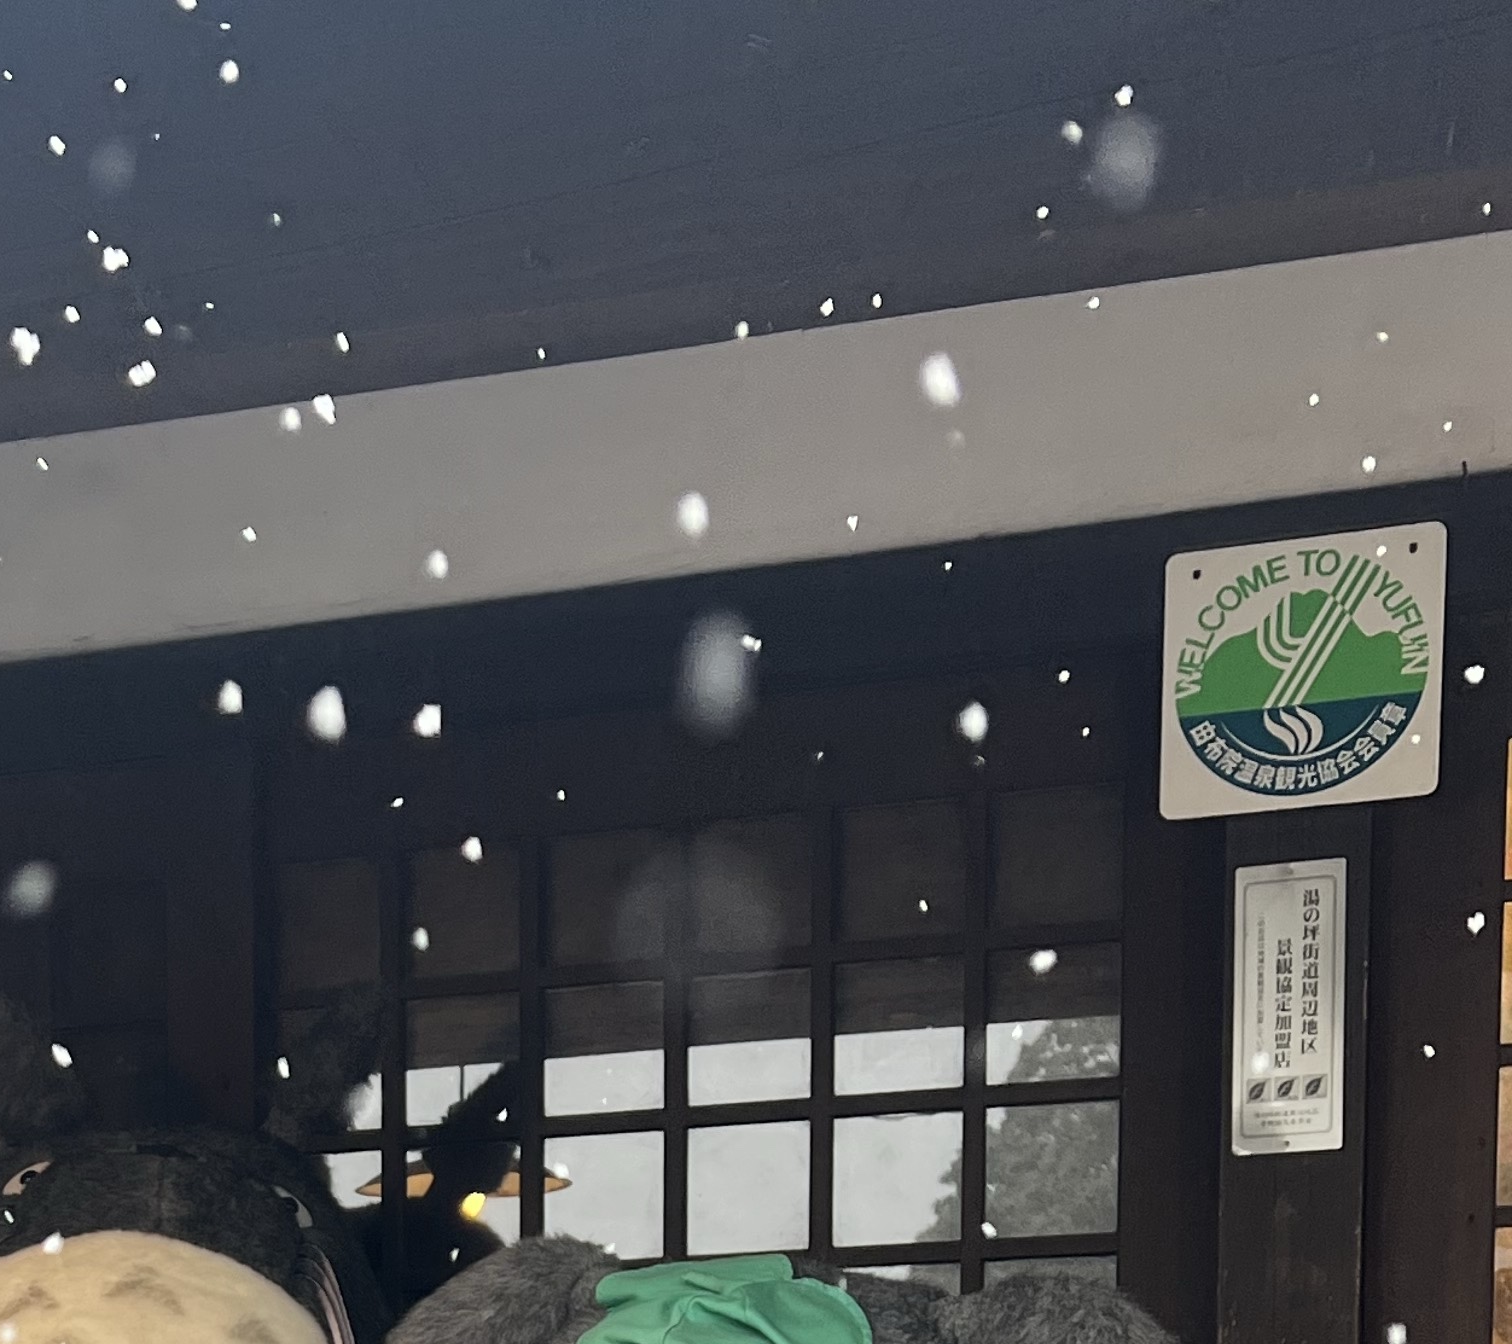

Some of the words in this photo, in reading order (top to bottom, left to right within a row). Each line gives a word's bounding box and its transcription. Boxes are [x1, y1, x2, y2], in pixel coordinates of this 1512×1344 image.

[1175, 555, 1290, 699] WELCOME
[1297, 549, 1341, 576] TO
[1373, 570, 1430, 675] YUFUIN
[1274, 937, 1293, 1069] 景観協定加盟店
[1301, 888, 1320, 1055] 湯の坪街道周辺地区
